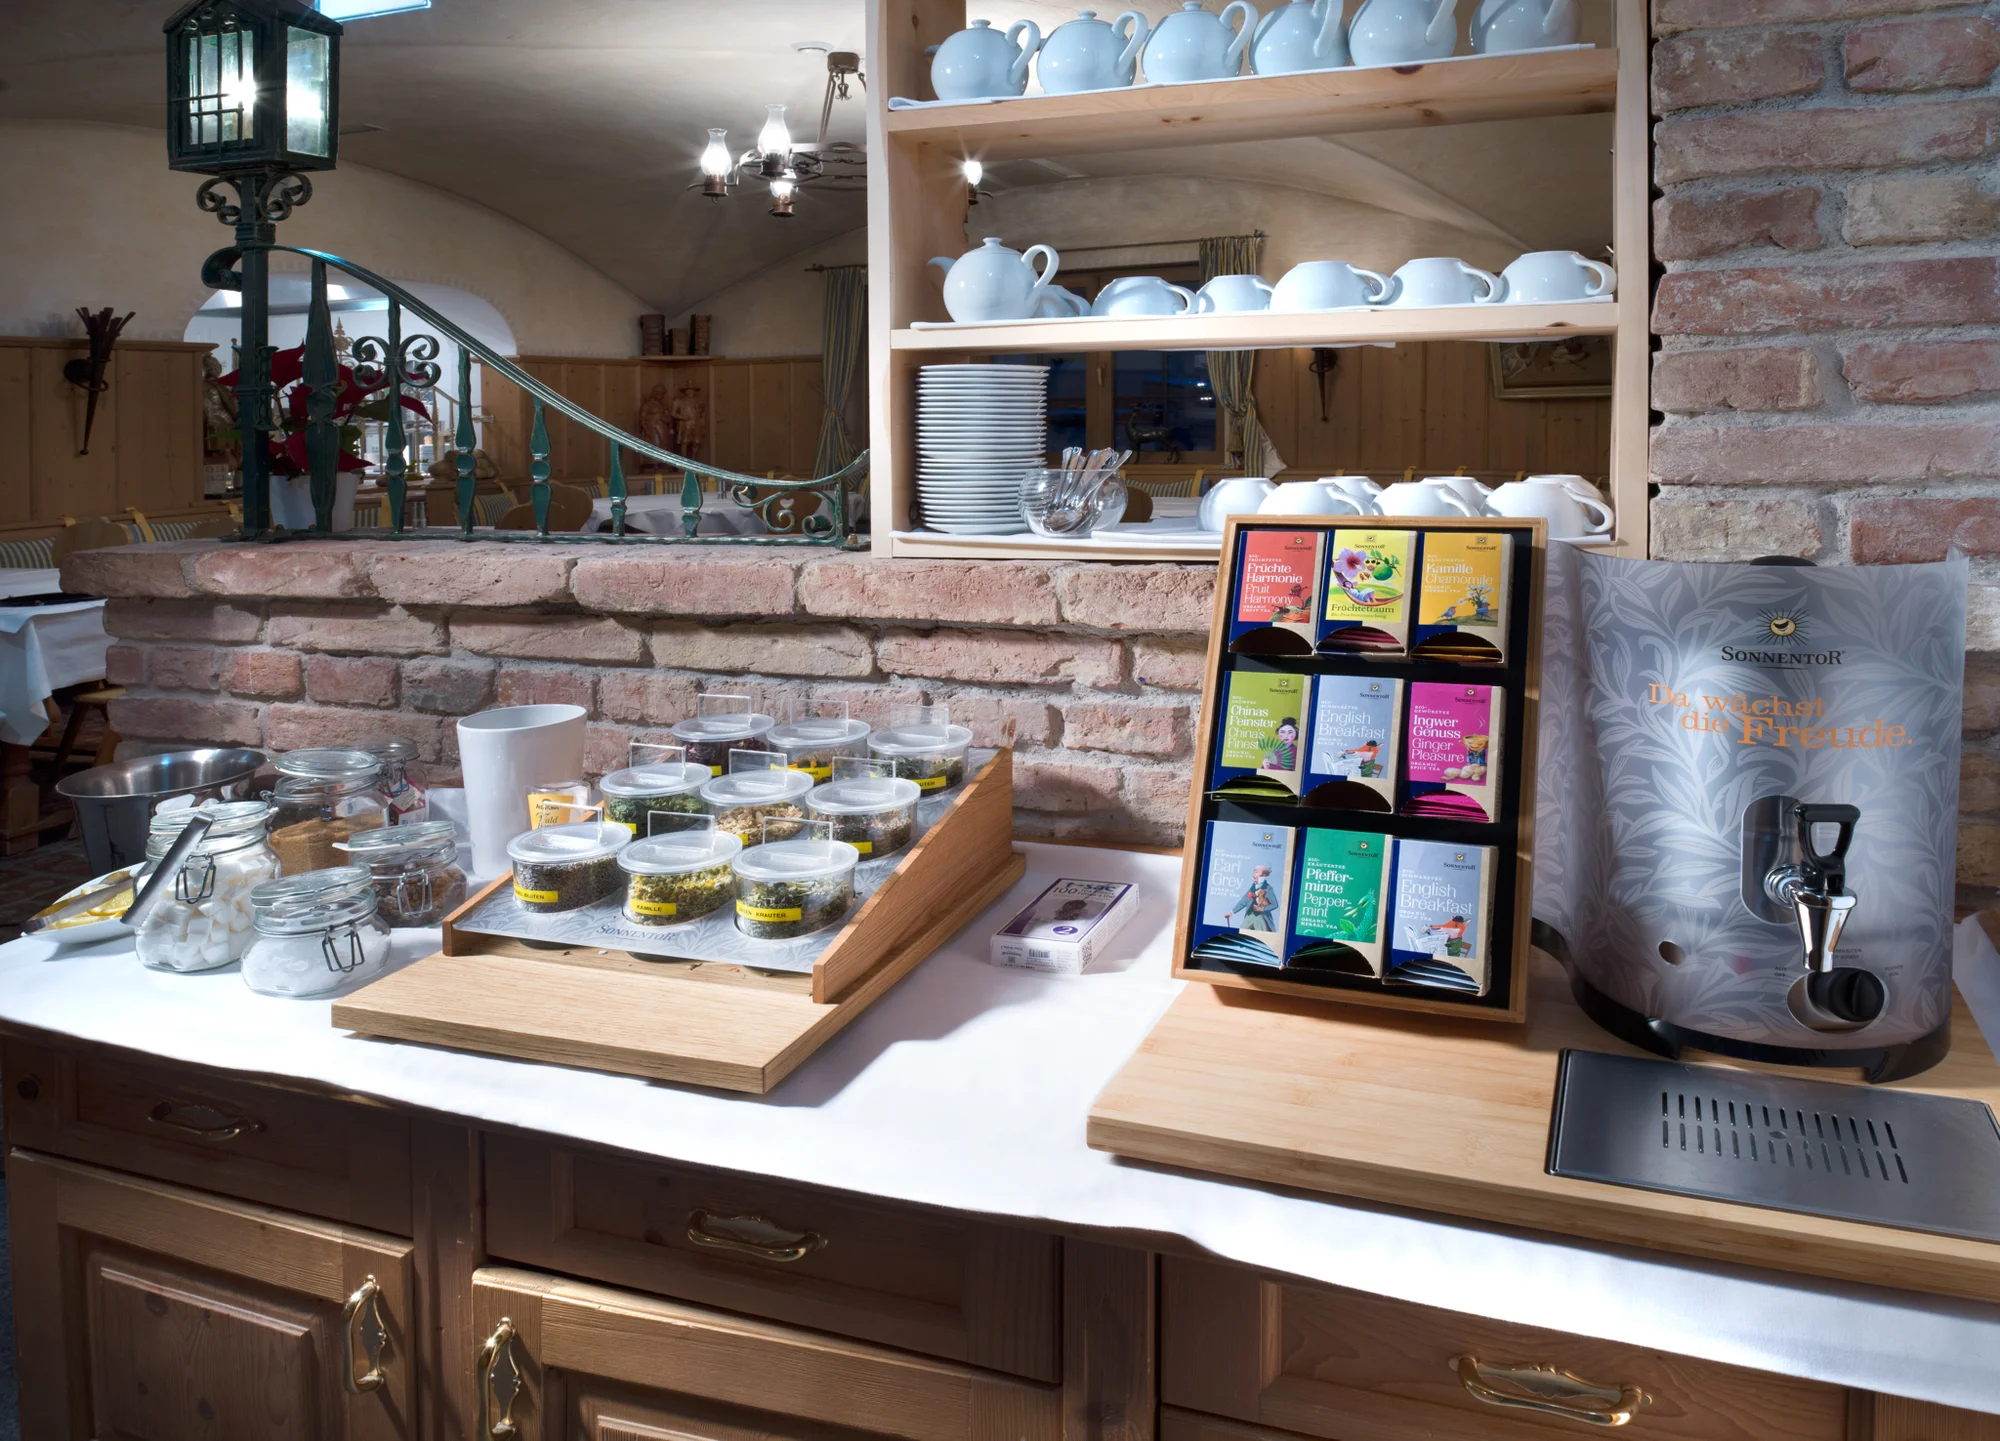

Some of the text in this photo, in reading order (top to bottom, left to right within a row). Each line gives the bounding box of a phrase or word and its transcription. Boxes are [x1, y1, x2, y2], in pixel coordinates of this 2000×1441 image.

[1248, 563, 1291, 573] Früchte
[1426, 564, 1473, 574] Kamille
[1246, 573, 1302, 583] Harmonie
[1425, 574, 1493, 584] Chamomile
[1246, 584, 1269, 593] Fruit
[1244, 594, 1293, 605] Harmony
[1331, 604, 1394, 613] Früchtetraum
[1721, 646, 1842, 665] SONNENTOR
[1649, 683, 1828, 717] Da wächst
[1230, 705, 1268, 716] Chinas
[1230, 716, 1276, 728] Feinster
[1320, 710, 1370, 726] English
[1414, 714, 1458, 729] Ingwer
[1320, 723, 1386, 739] Breakfast
[1413, 726, 1460, 738] Genuss
[1681, 711, 1913, 749] die Freude.
[1227, 738, 1259, 749] Finest
[1412, 738, 1454, 752] Ginger
[1411, 749, 1464, 763] Pleasure
[1213, 858, 1241, 873] Earl
[1212, 872, 1244, 889] Grey
[1306, 868, 1353, 883] Pfeffer-
[1305, 881, 1343, 894] minze
[1402, 879, 1456, 899] English
[1304, 892, 1352, 908] Pepper-
[1400, 894, 1472, 915] Breakfast
[1302, 905, 1328, 917] mint
[596, 925, 676, 942] SONNENTOR
